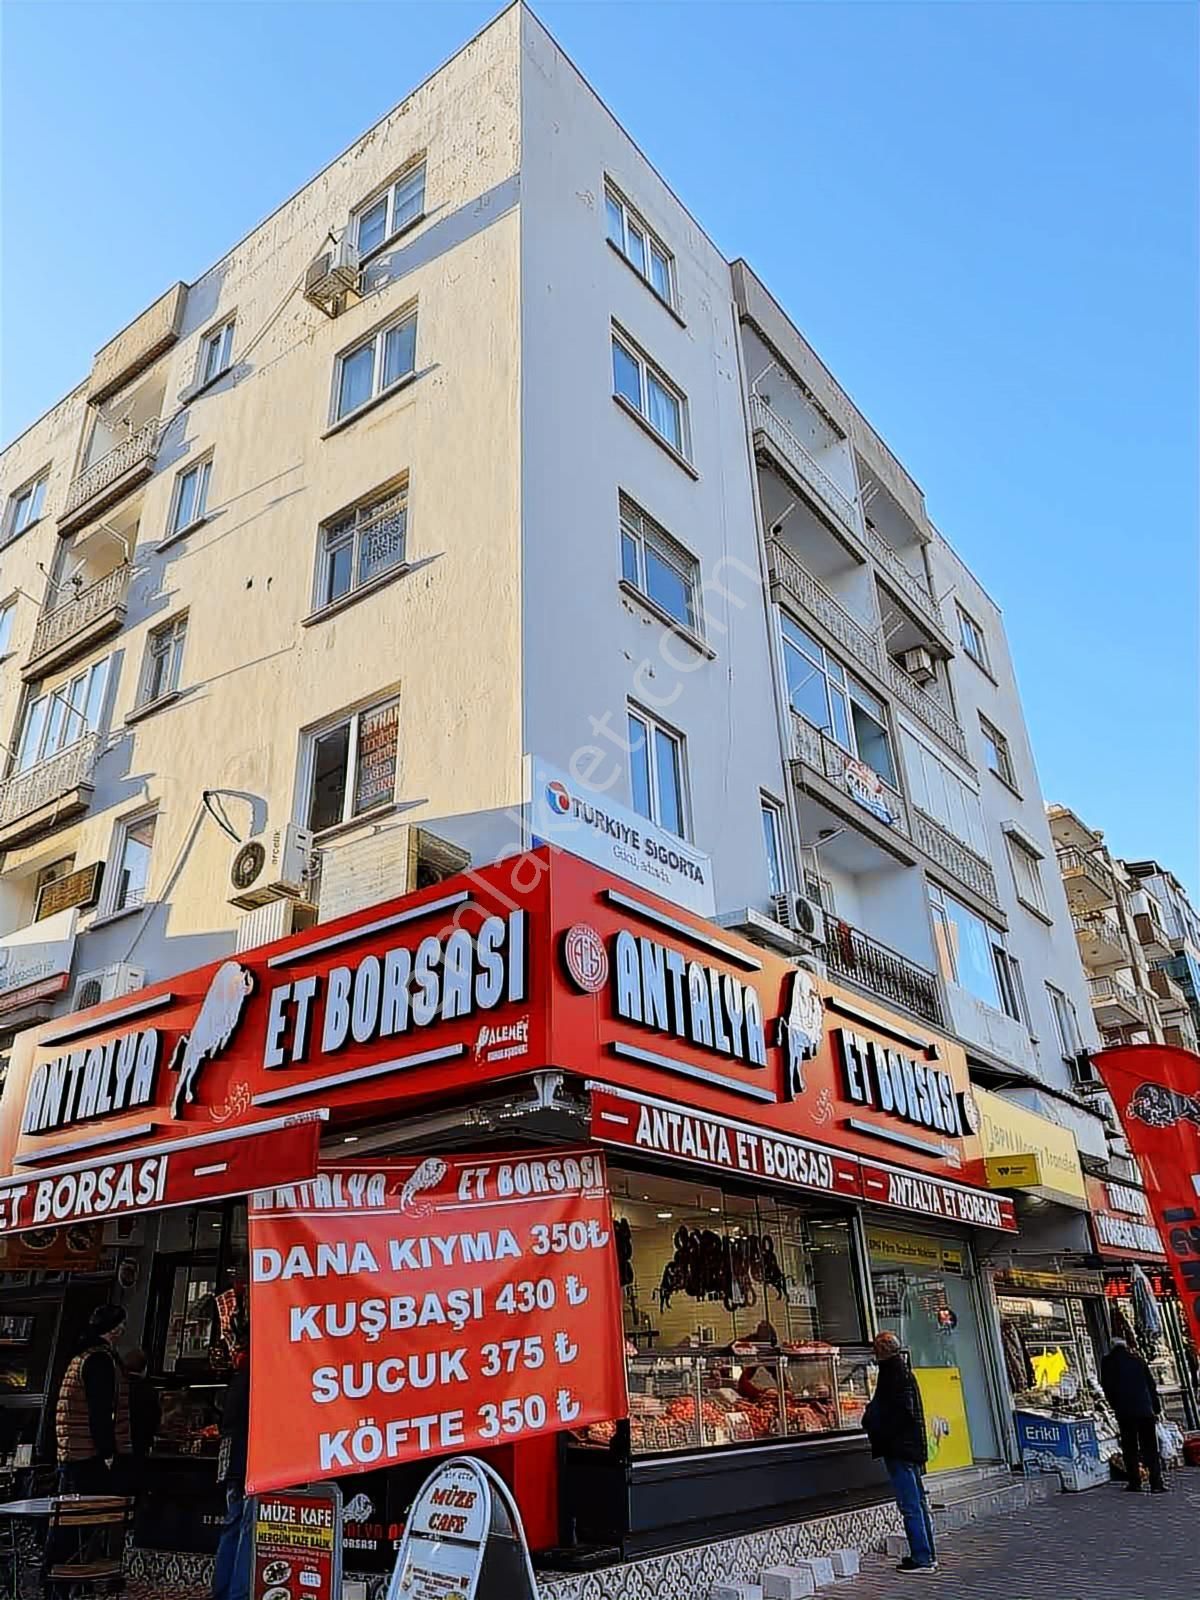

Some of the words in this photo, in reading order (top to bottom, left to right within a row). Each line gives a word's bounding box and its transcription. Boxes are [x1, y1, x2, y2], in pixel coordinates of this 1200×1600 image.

[23, 1028, 158, 1134] ANTALYA
[264, 980, 316, 1069] ET
[322, 910, 524, 1054] BORSASI
[614, 930, 767, 1067] ANTALYA
[843, 1028, 872, 1104] ET
[874, 1040, 963, 1136] BORSASI
[636, 1105, 733, 1167] ANTALYA
[737, 1132, 759, 1182] ET
[762, 1138, 833, 1189] BORSASI
[32, 1155, 168, 1222] BORSASI
[458, 1167, 490, 1201] ET
[498, 1155, 603, 1197] BORSASI
[888, 1172, 942, 1214] ANTALYA
[943, 1187, 957, 1217] ET
[958, 1191, 1002, 1226] BORSASI
[253, 1243, 378, 1282] DANA
[390, 1230, 522, 1271] KIYMA
[289, 1289, 483, 1342] KUŞBAŞI
[495, 1283, 555, 1315] 430
[312, 1348, 468, 1403] SUCUK
[481, 1335, 545, 1377] 375
[319, 1410, 466, 1471] KÖFTE
[478, 1394, 546, 1437] 350
[1025, 1426, 1060, 1441] Erikli
[260, 1501, 296, 1523] MÜZE
[300, 1508, 332, 1527] KAFE
[428, 1512, 467, 1533] CAFE
[430, 1484, 477, 1508] MÜZE
